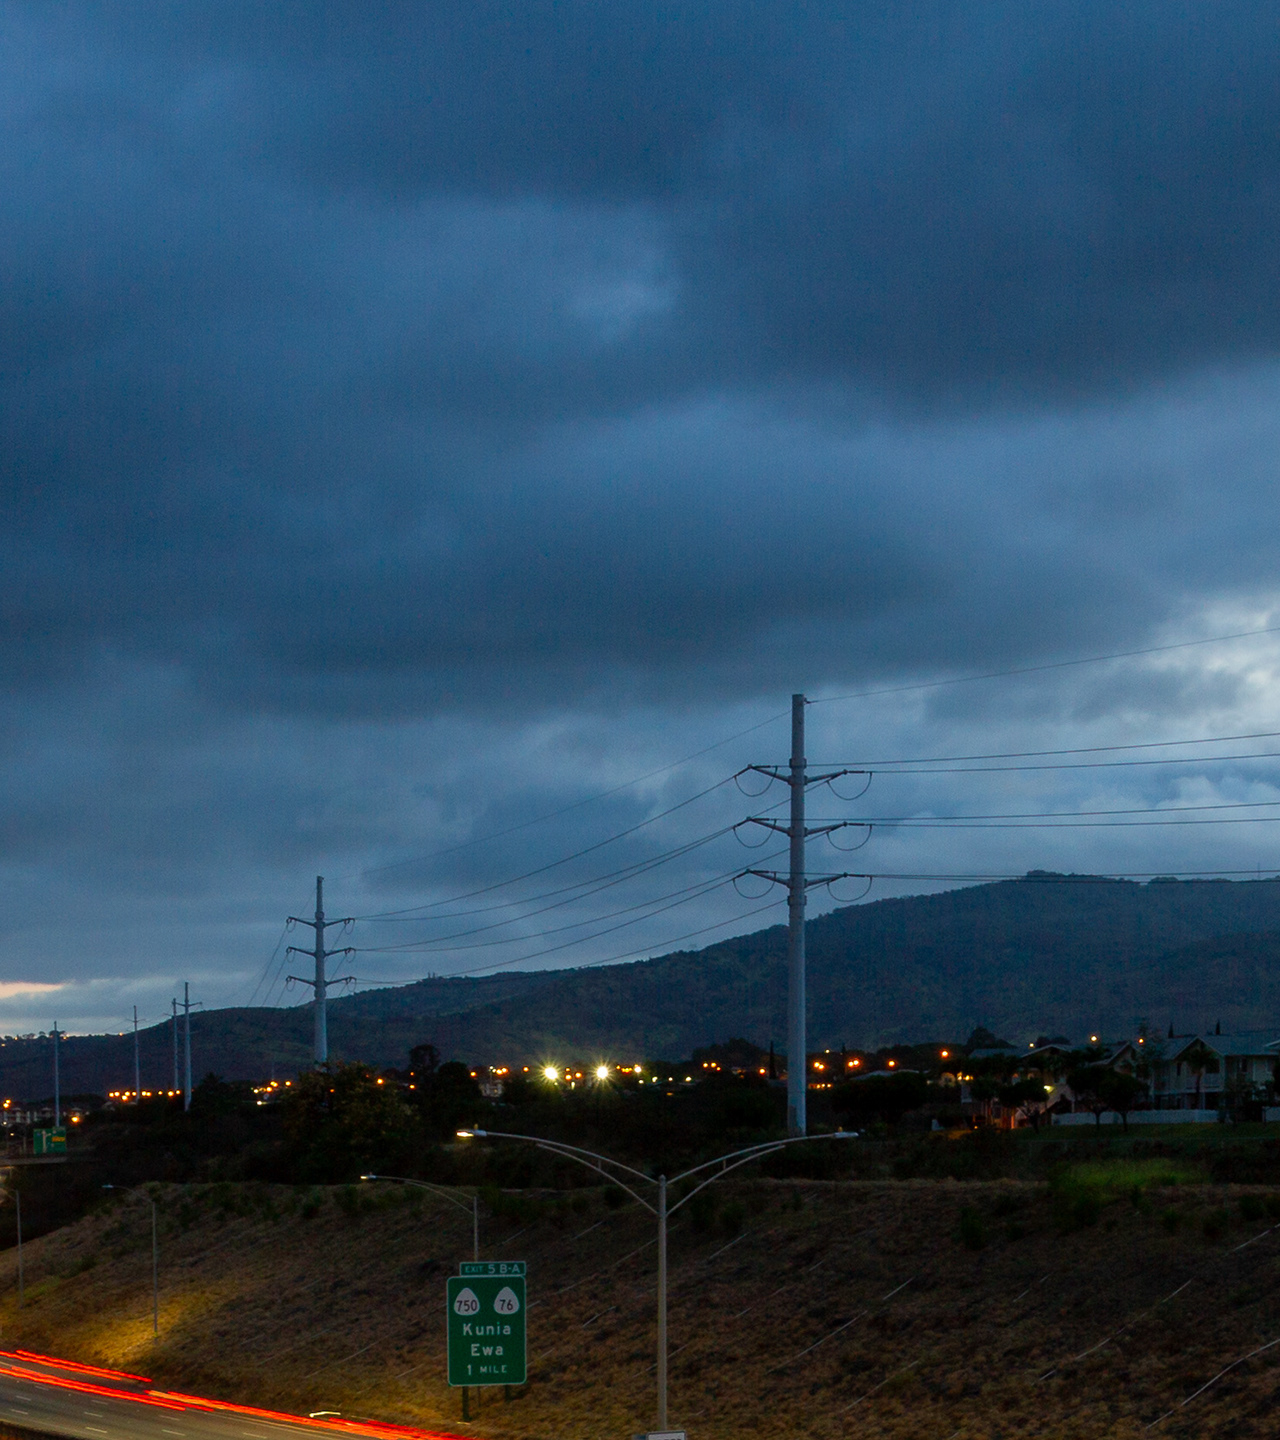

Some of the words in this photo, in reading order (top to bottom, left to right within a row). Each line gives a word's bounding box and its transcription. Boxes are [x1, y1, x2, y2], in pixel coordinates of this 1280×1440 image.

[488, 1264, 496, 1274] 5
[457, 1299, 478, 1312] 750
[500, 1299, 514, 1311] 76
[463, 1322, 511, 1336] Kunia
[471, 1343, 504, 1356] Ewa
[467, 1364, 472, 1375] 1
[480, 1364, 507, 1373] MILE
